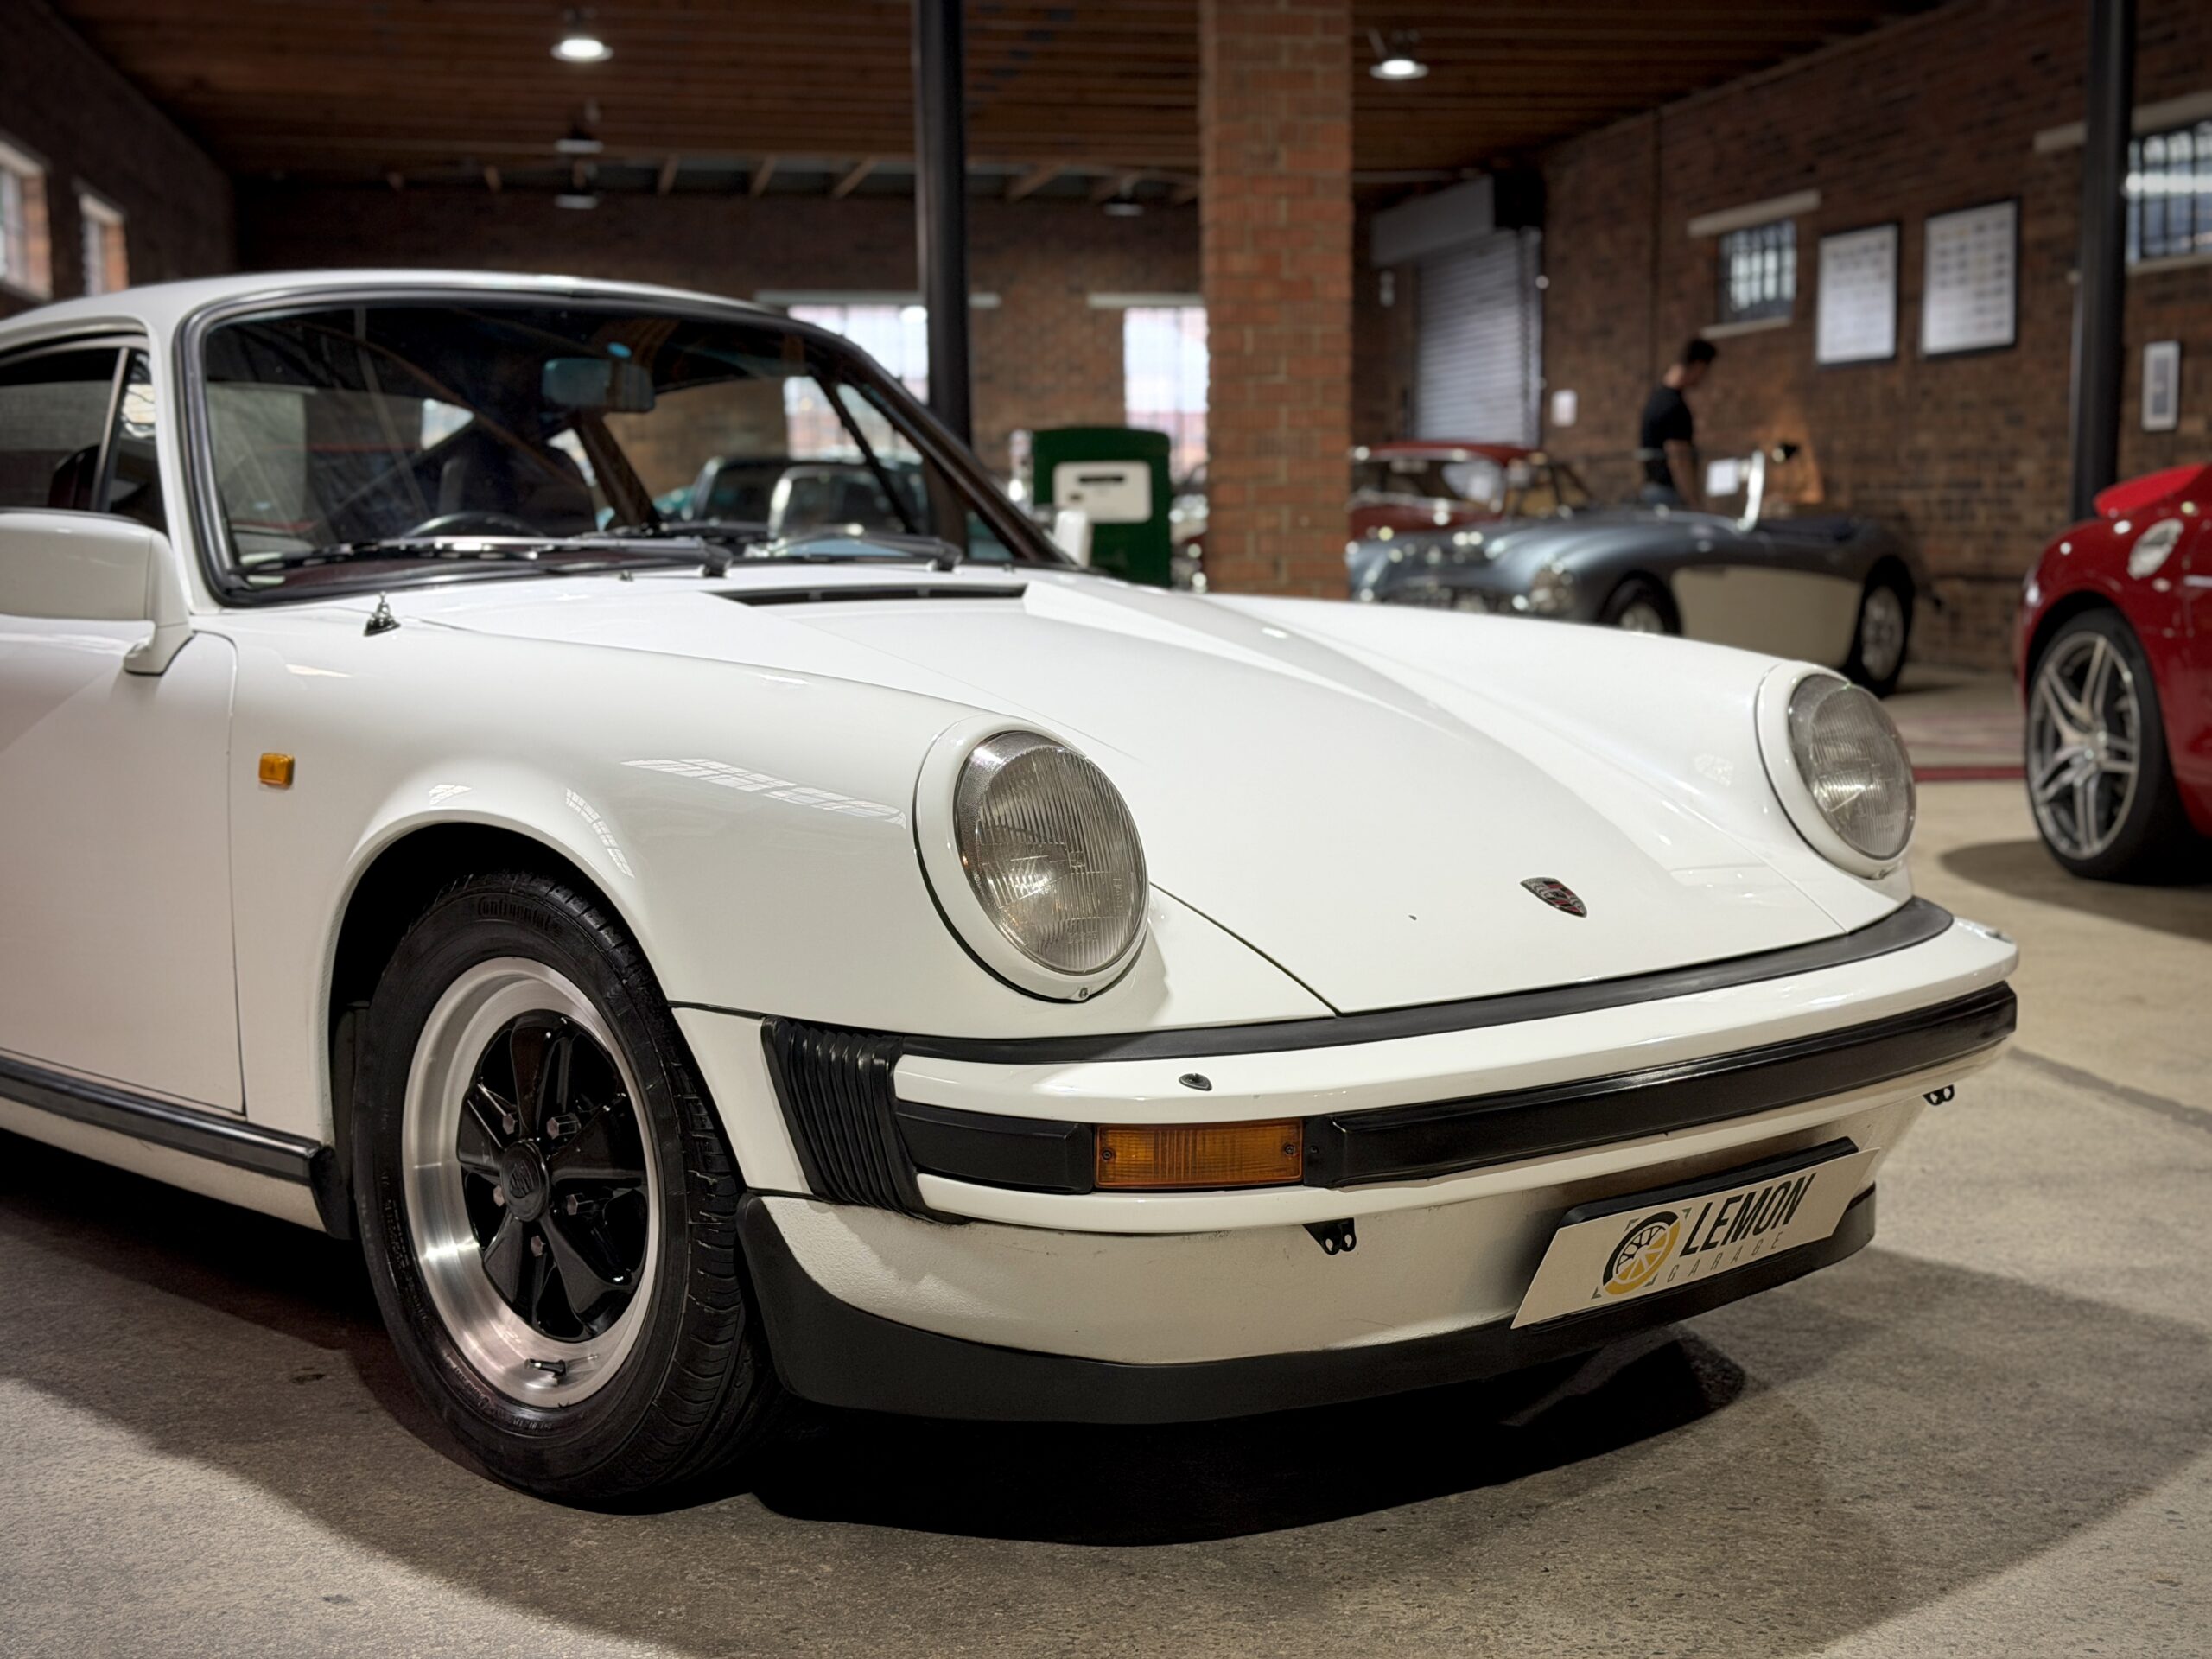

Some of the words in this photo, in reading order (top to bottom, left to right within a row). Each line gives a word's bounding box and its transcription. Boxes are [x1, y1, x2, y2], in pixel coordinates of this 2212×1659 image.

[478, 896, 551, 931] Continental
[1680, 1173, 1817, 1257] LEMON
[1667, 1231, 1783, 1283] GARAGE
